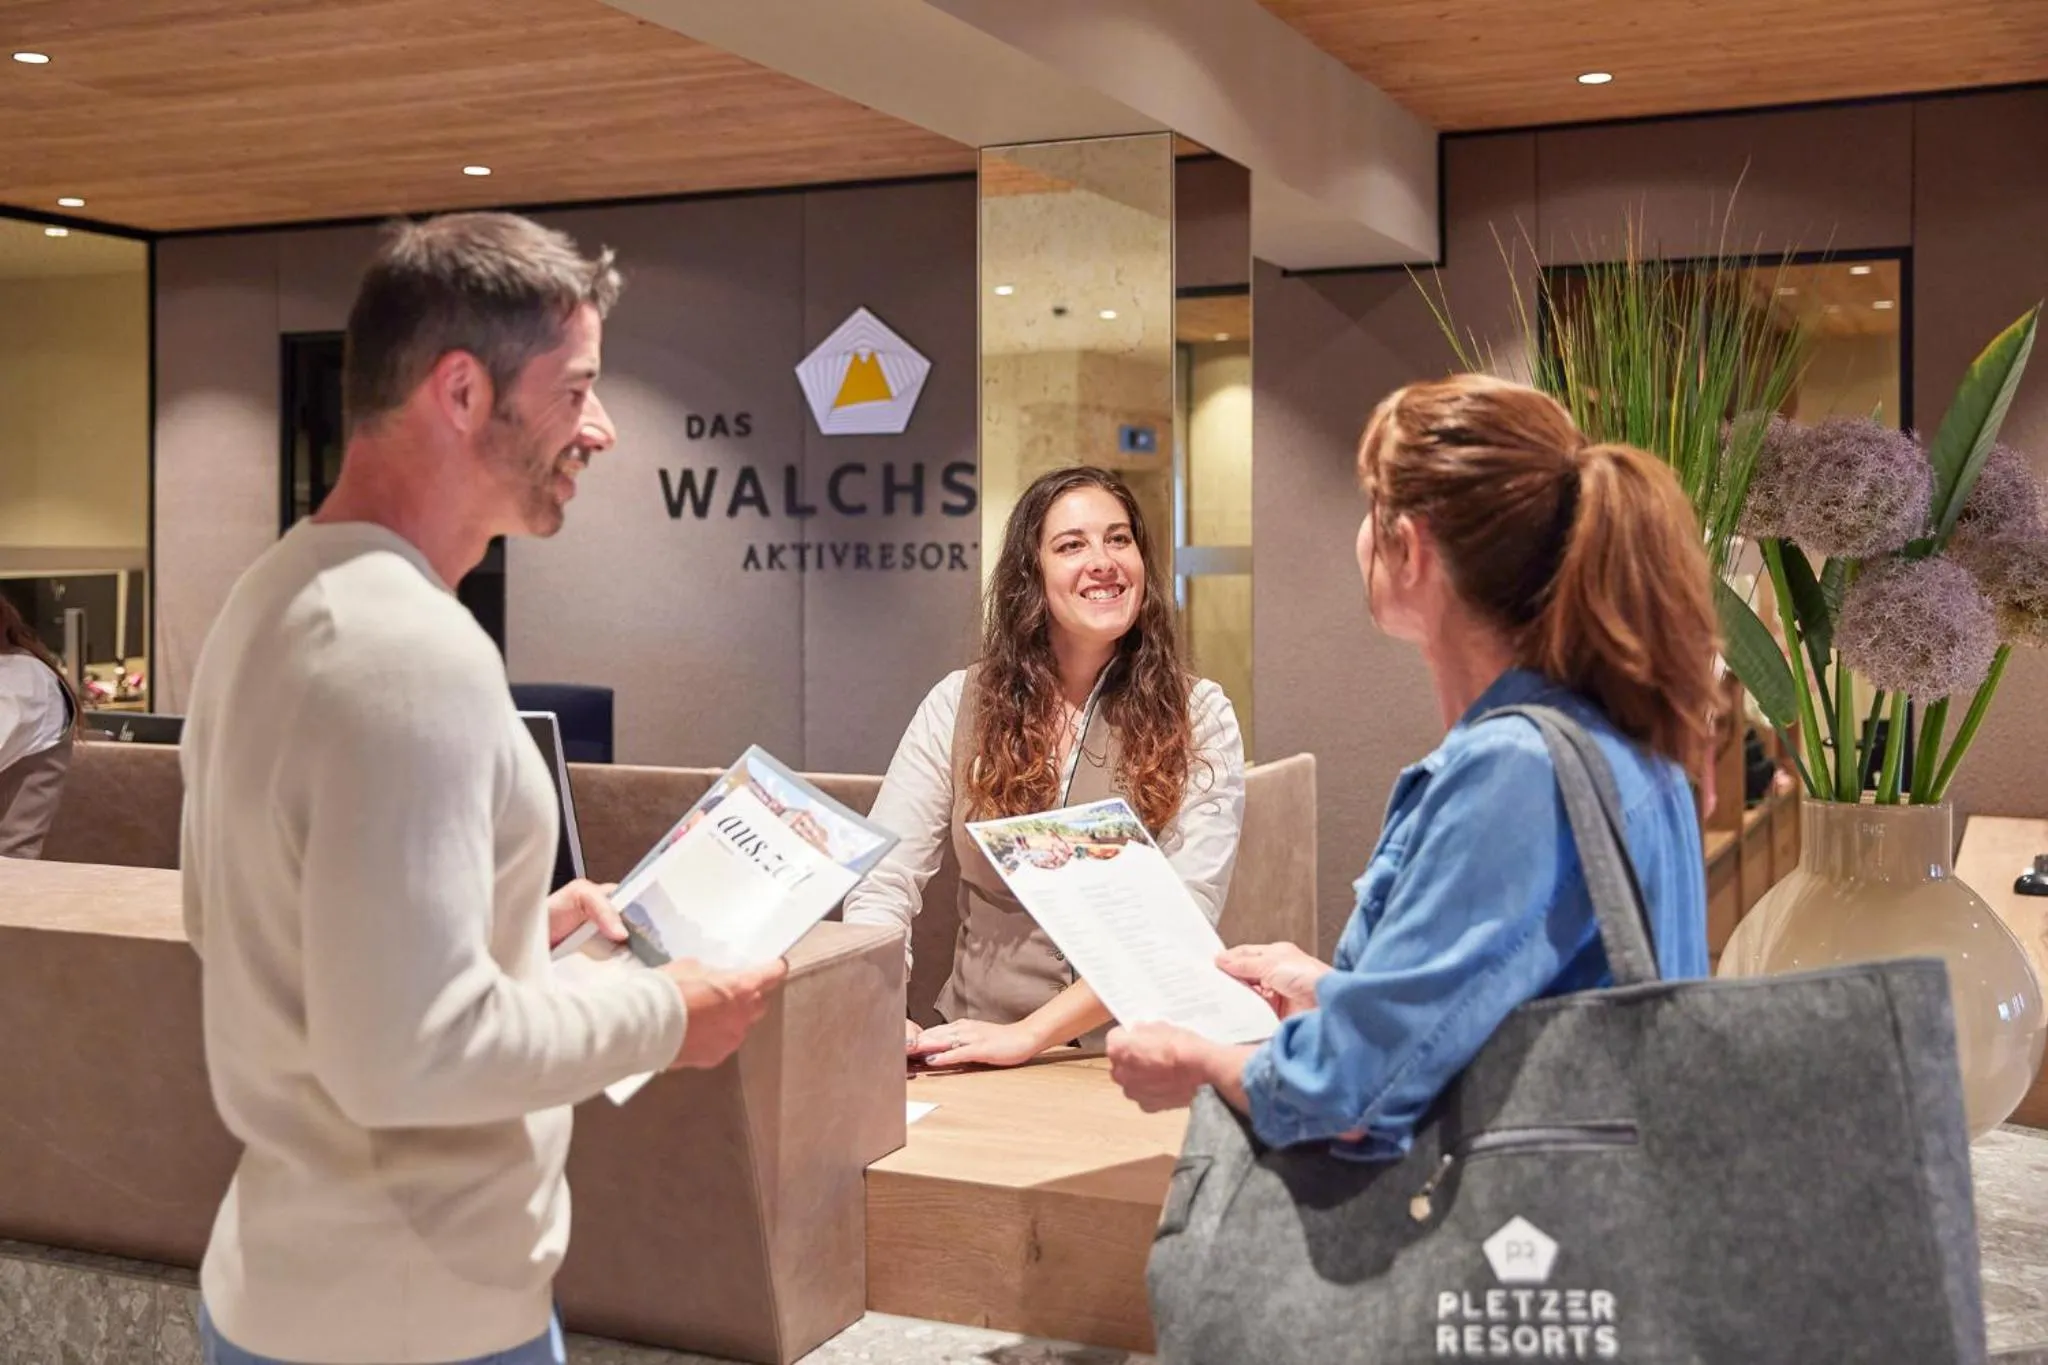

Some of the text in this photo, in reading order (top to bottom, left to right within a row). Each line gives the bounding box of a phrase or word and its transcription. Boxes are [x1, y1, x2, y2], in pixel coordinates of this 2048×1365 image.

[685, 413, 752, 439] DAS
[657, 461, 977, 520] WALCHS
[742, 542, 979, 572] AKTIVRESOR
[1437, 1288, 1616, 1321] PLETZER
[1436, 1323, 1618, 1359] RESORTS
